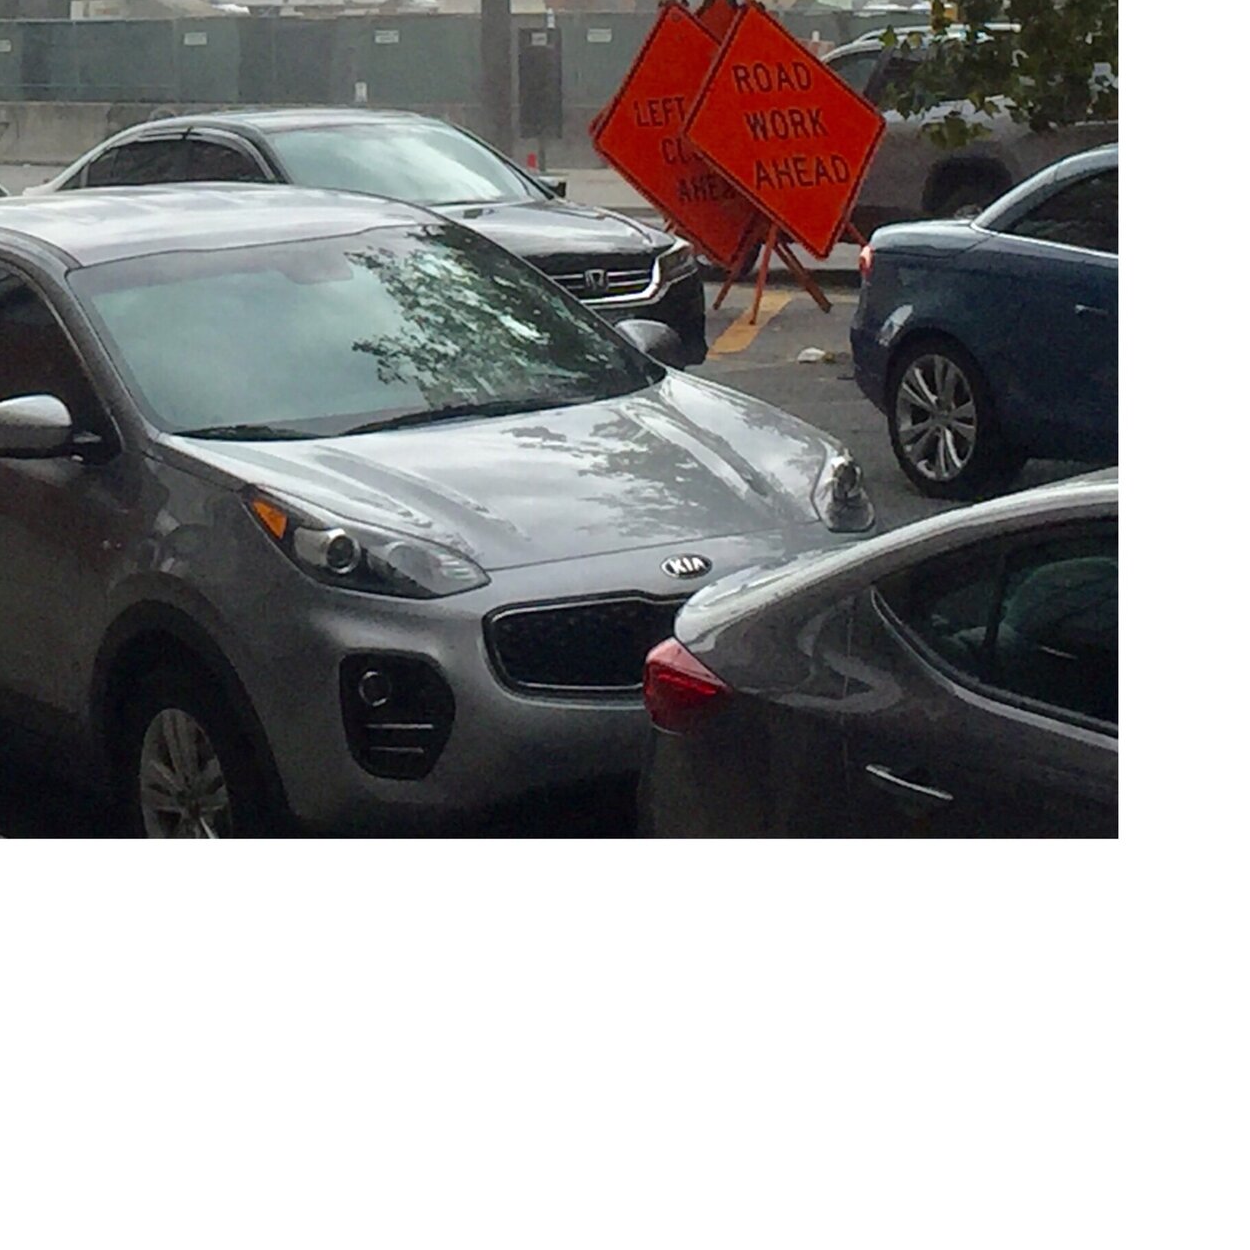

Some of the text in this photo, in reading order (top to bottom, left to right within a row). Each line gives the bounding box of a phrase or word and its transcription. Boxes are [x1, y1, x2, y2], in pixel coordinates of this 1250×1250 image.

[732, 62, 813, 94] ROAD
[634, 96, 686, 128] LEFT
[745, 108, 829, 141] WORK
[755, 153, 851, 191] AHEAD
[668, 557, 707, 574] KIA
